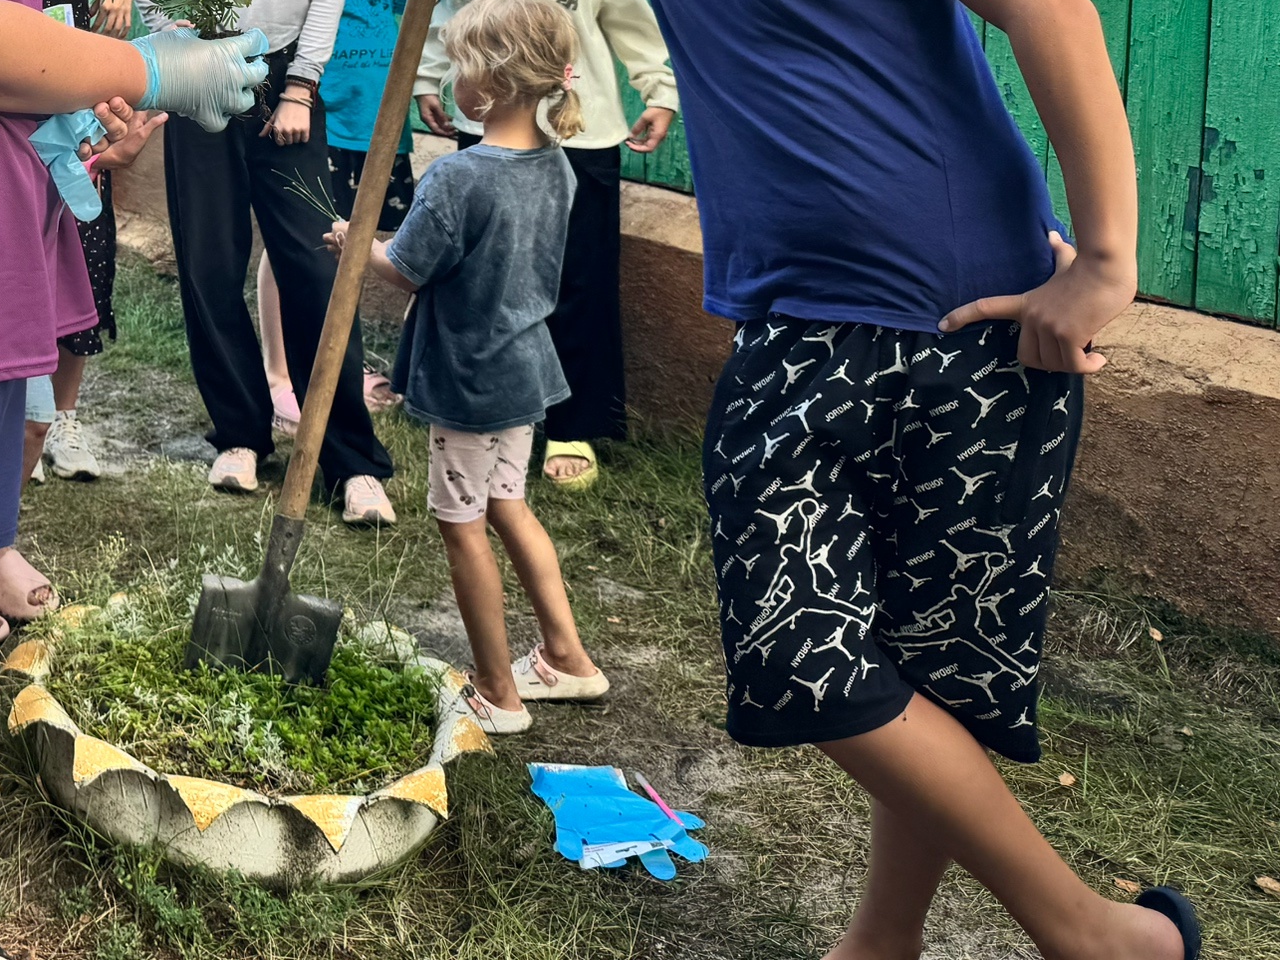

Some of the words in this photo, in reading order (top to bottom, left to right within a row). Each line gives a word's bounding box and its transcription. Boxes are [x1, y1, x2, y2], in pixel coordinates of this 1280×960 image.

[331, 49, 377, 60] HAPPY
[752, 370, 777, 392] JORDAN
[971, 358, 998, 382] JORDAN
[825, 400, 855, 423] JORDAN
[928, 400, 959, 418] JORDAN
[1005, 404, 1026, 423] JORD
[791, 434, 814, 459] JORDAN
[956, 438, 987, 462] JORDAN
[1039, 431, 1065, 456] JORDAN
[757, 476, 783, 503] JORDAN
[914, 477, 944, 494] JORDAN
[946, 516, 977, 536] JORDAN
[1027, 512, 1051, 540] JORDAN
[846, 531, 867, 561] JORDAN
[905, 549, 936, 567] JORDAN
[1018, 592, 1045, 617] JORDAN
[790, 637, 814, 669] JORDAN
[842, 665, 859, 697] JORDAN
[928, 663, 960, 681] JORDAN
